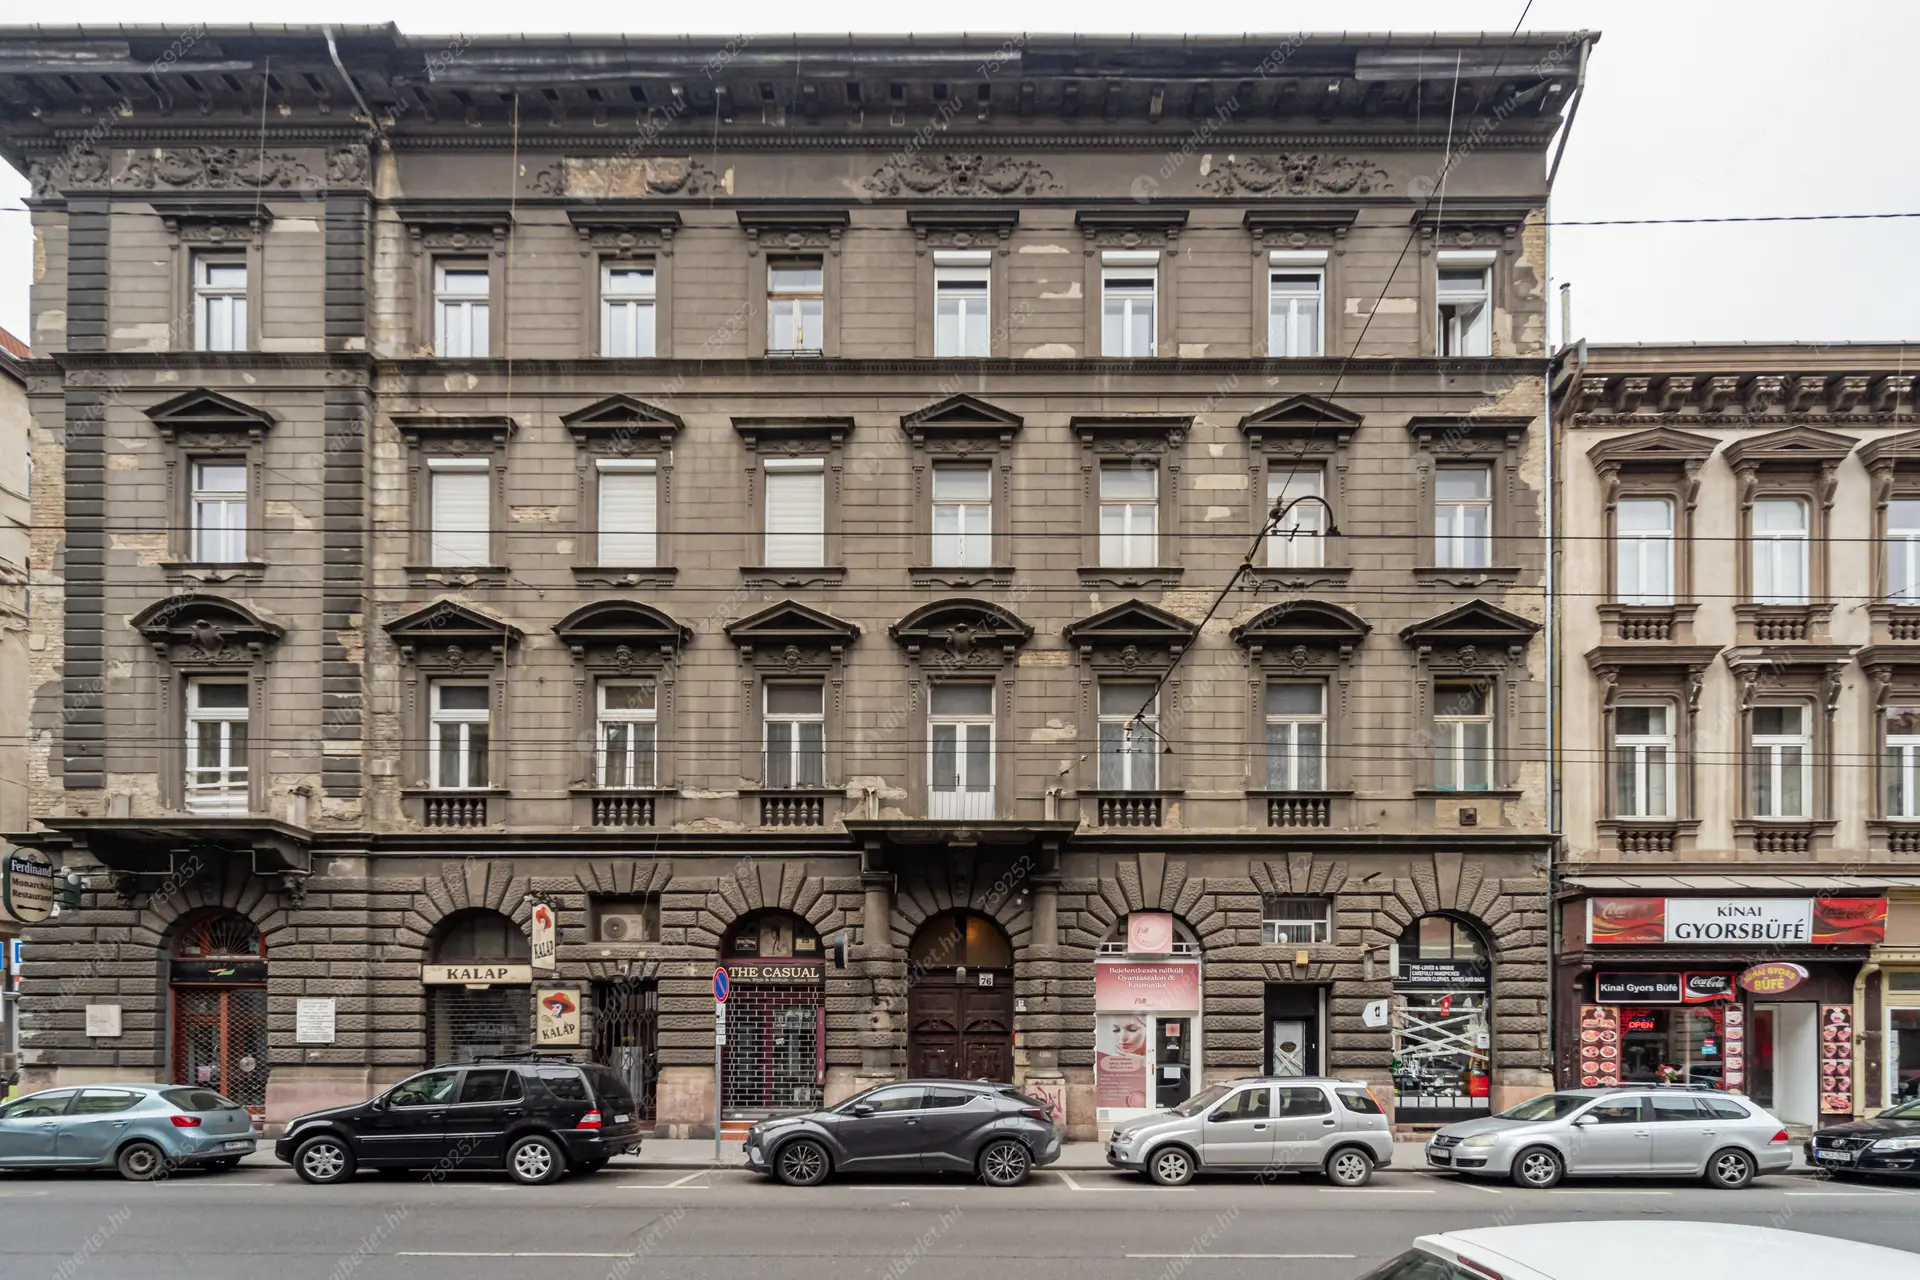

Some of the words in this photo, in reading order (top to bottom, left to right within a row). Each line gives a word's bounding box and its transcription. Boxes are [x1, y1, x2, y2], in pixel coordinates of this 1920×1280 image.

[11, 859, 52, 877] Ferdinand
[12, 878, 52, 891] Monarchia
[12, 889, 52, 902] Restaurant
[1717, 903, 1762, 917] KÍNAI
[1675, 919, 1804, 939] GYORSBÜFÉ
[534, 940, 554, 960] KALAP
[447, 968, 508, 980] KALAP
[729, 966, 758, 977] THE
[762, 966, 819, 978] CASUAL
[1767, 967, 1796, 980] GYORS
[980, 977, 992, 985] 76
[1753, 975, 1785, 991] BÜFÉ
[1626, 984, 1654, 993] Gyors
[1656, 983, 1677, 992] Büfé
[542, 1022, 575, 1040] KALAP
